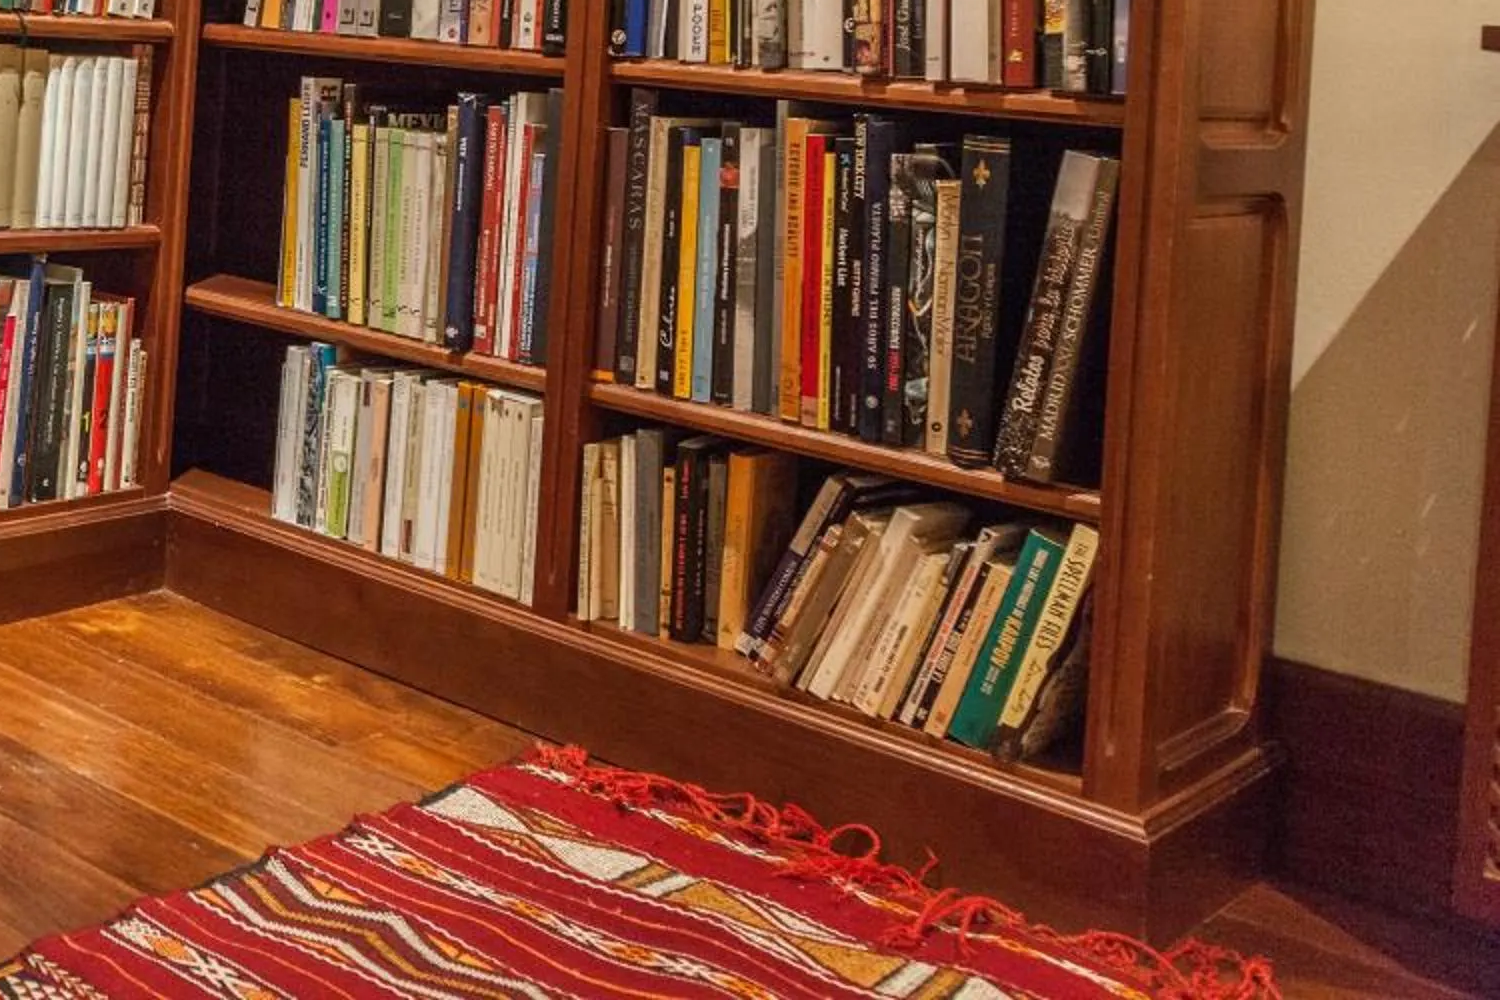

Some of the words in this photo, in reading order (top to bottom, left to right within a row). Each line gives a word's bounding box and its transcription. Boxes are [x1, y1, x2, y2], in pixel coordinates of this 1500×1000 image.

[855, 175, 865, 199] CITY
[871, 202, 882, 251] PLANETA
[837, 228, 849, 265] Herbert
[837, 267, 848, 286] List
[870, 253, 880, 295] PREMIO
[869, 299, 879, 319] DEL
[867, 323, 878, 353] AÑOS
[1039, 374, 1066, 441] MADRID
[1063, 247, 1097, 342] SCHOMMER
[867, 355, 877, 369] 50
[1012, 354, 1044, 413] Relatos
[1049, 558, 1087, 619] SPELLMAN
[1035, 620, 1061, 650] FILES
